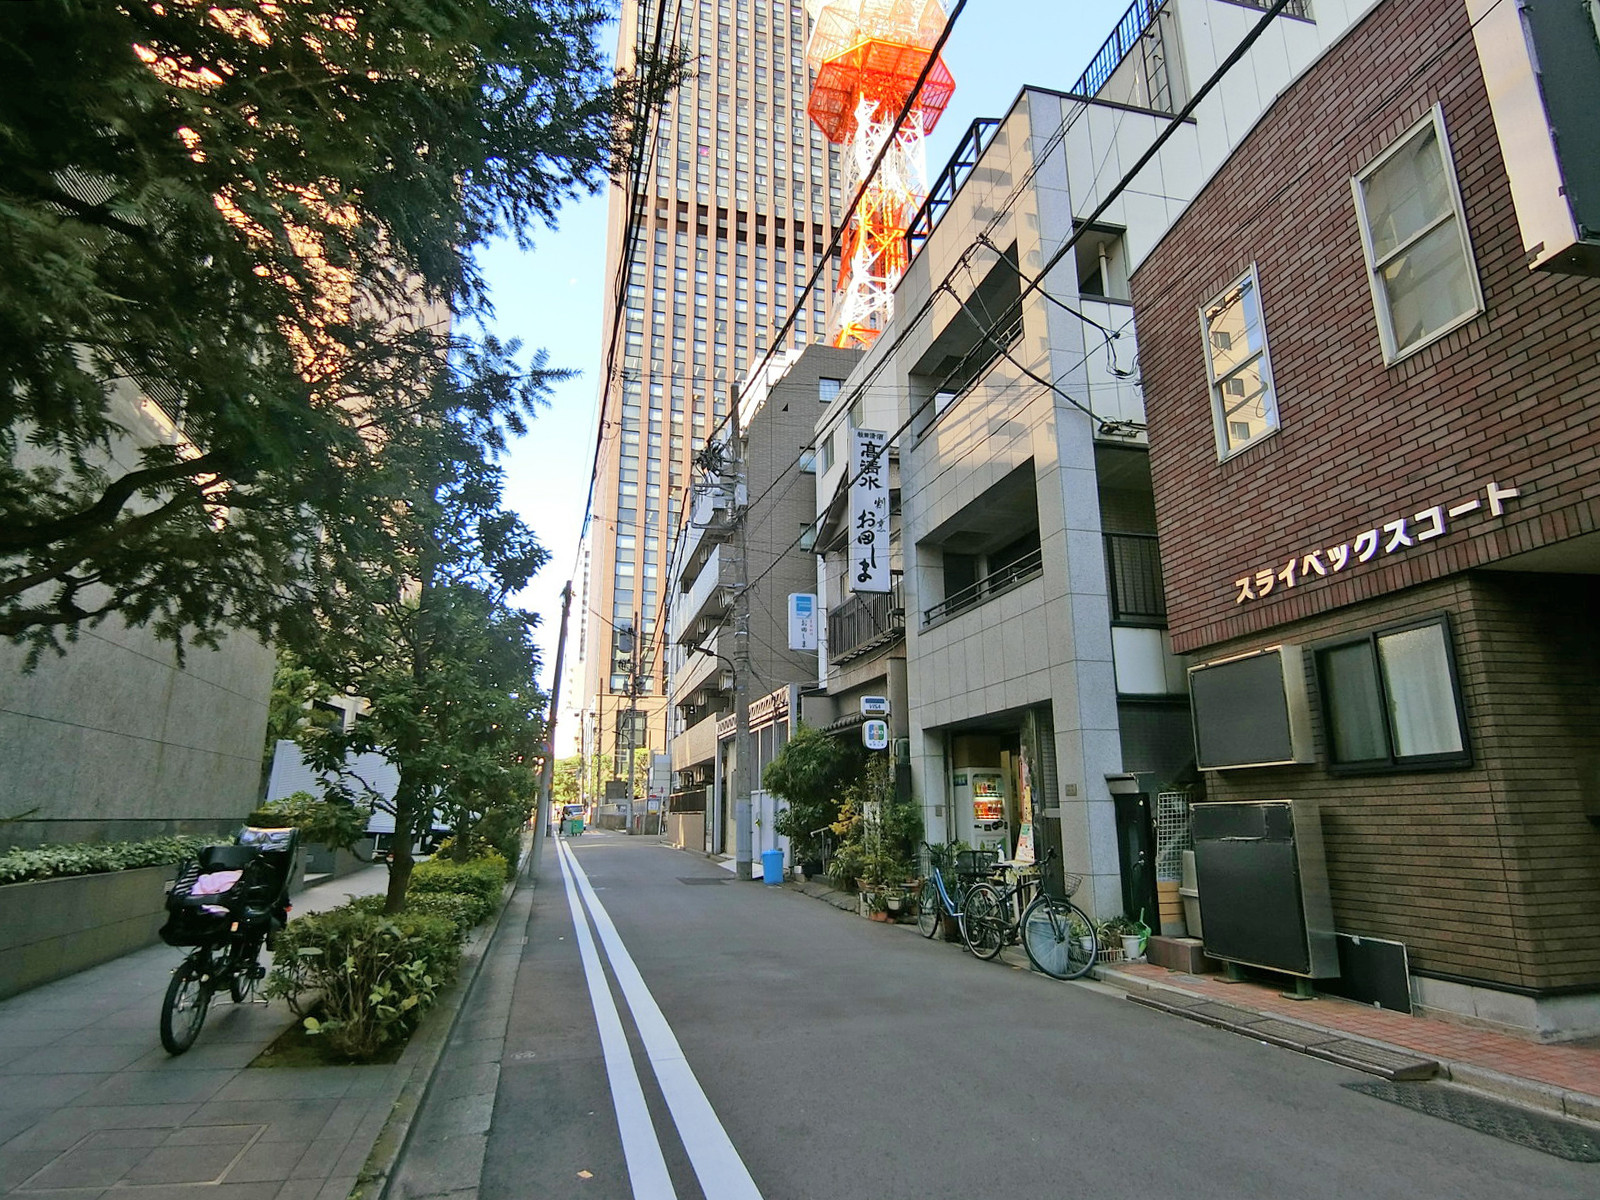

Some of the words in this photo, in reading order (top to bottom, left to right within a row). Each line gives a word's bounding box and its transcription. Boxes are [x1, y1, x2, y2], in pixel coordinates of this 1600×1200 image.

[1235, 482, 1520, 604] スライベックスコート
